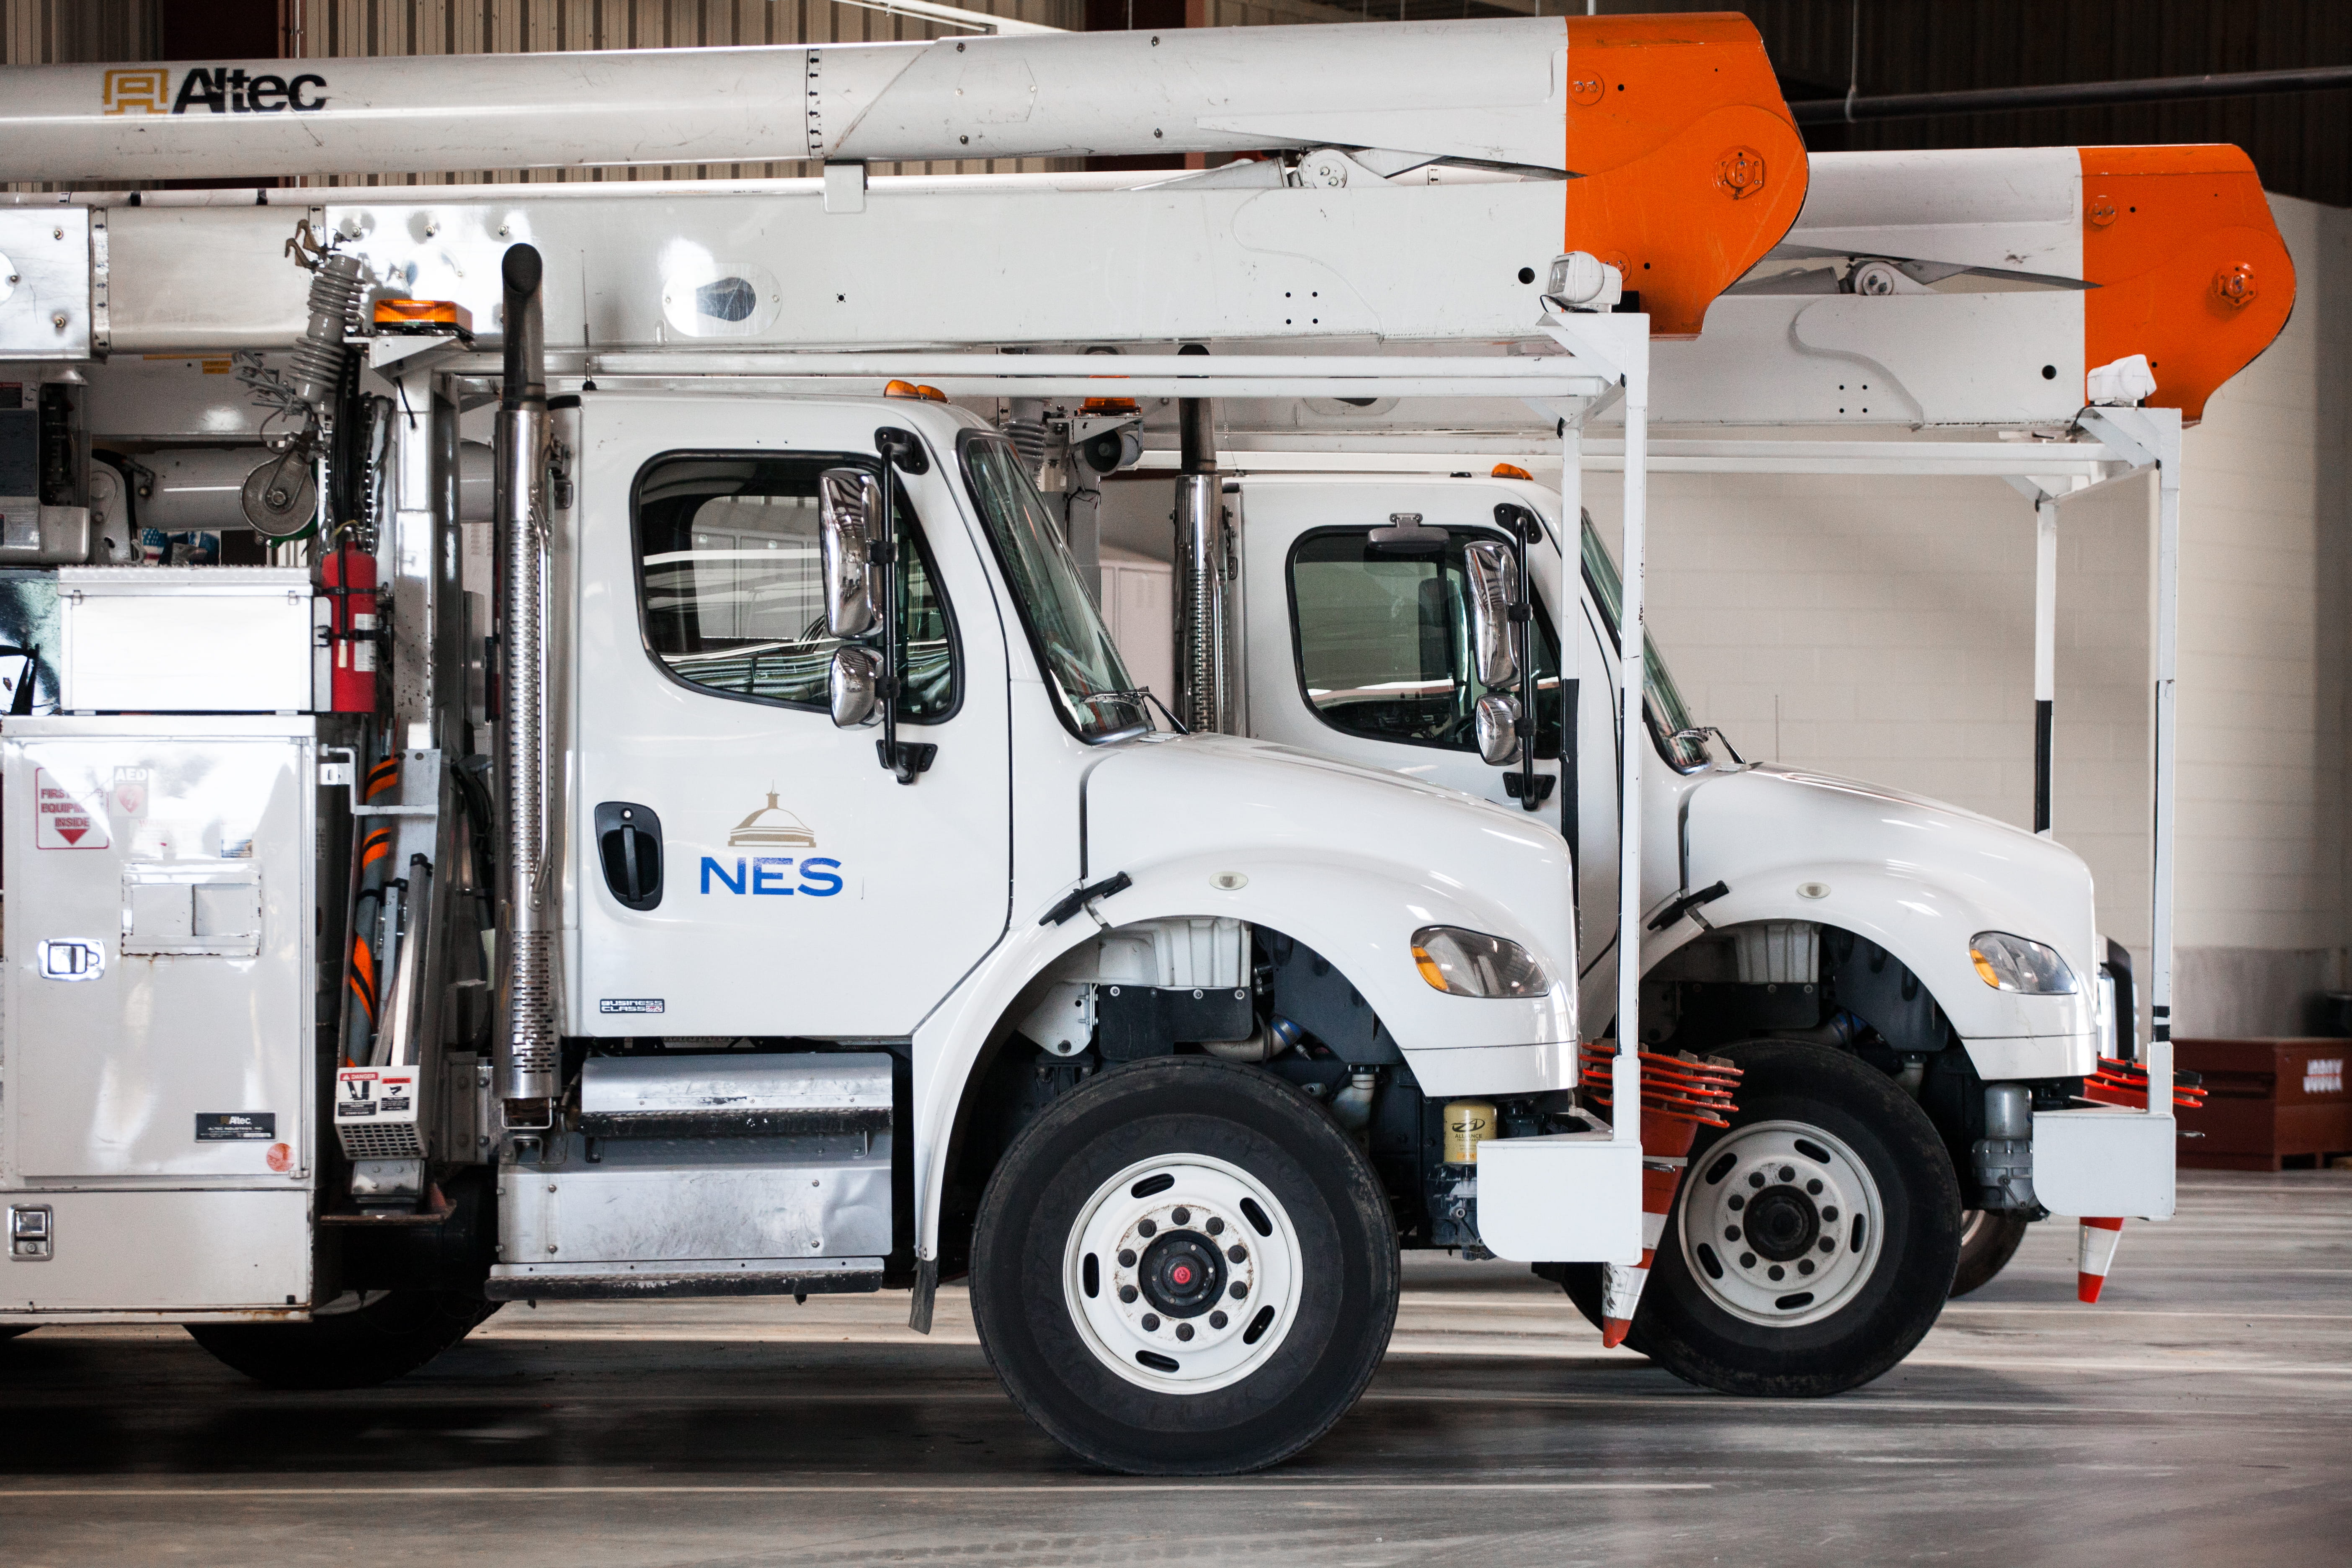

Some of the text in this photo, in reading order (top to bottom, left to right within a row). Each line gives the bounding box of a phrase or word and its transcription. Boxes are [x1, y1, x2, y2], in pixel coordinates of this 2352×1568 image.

[173, 67, 327, 113] Altec
[115, 768, 147, 781] AED
[41, 802, 104, 813] EQUIPM
[54, 818, 90, 827] INSIDE
[701, 857, 843, 897] NES
[229, 1116, 252, 1124] Altec
